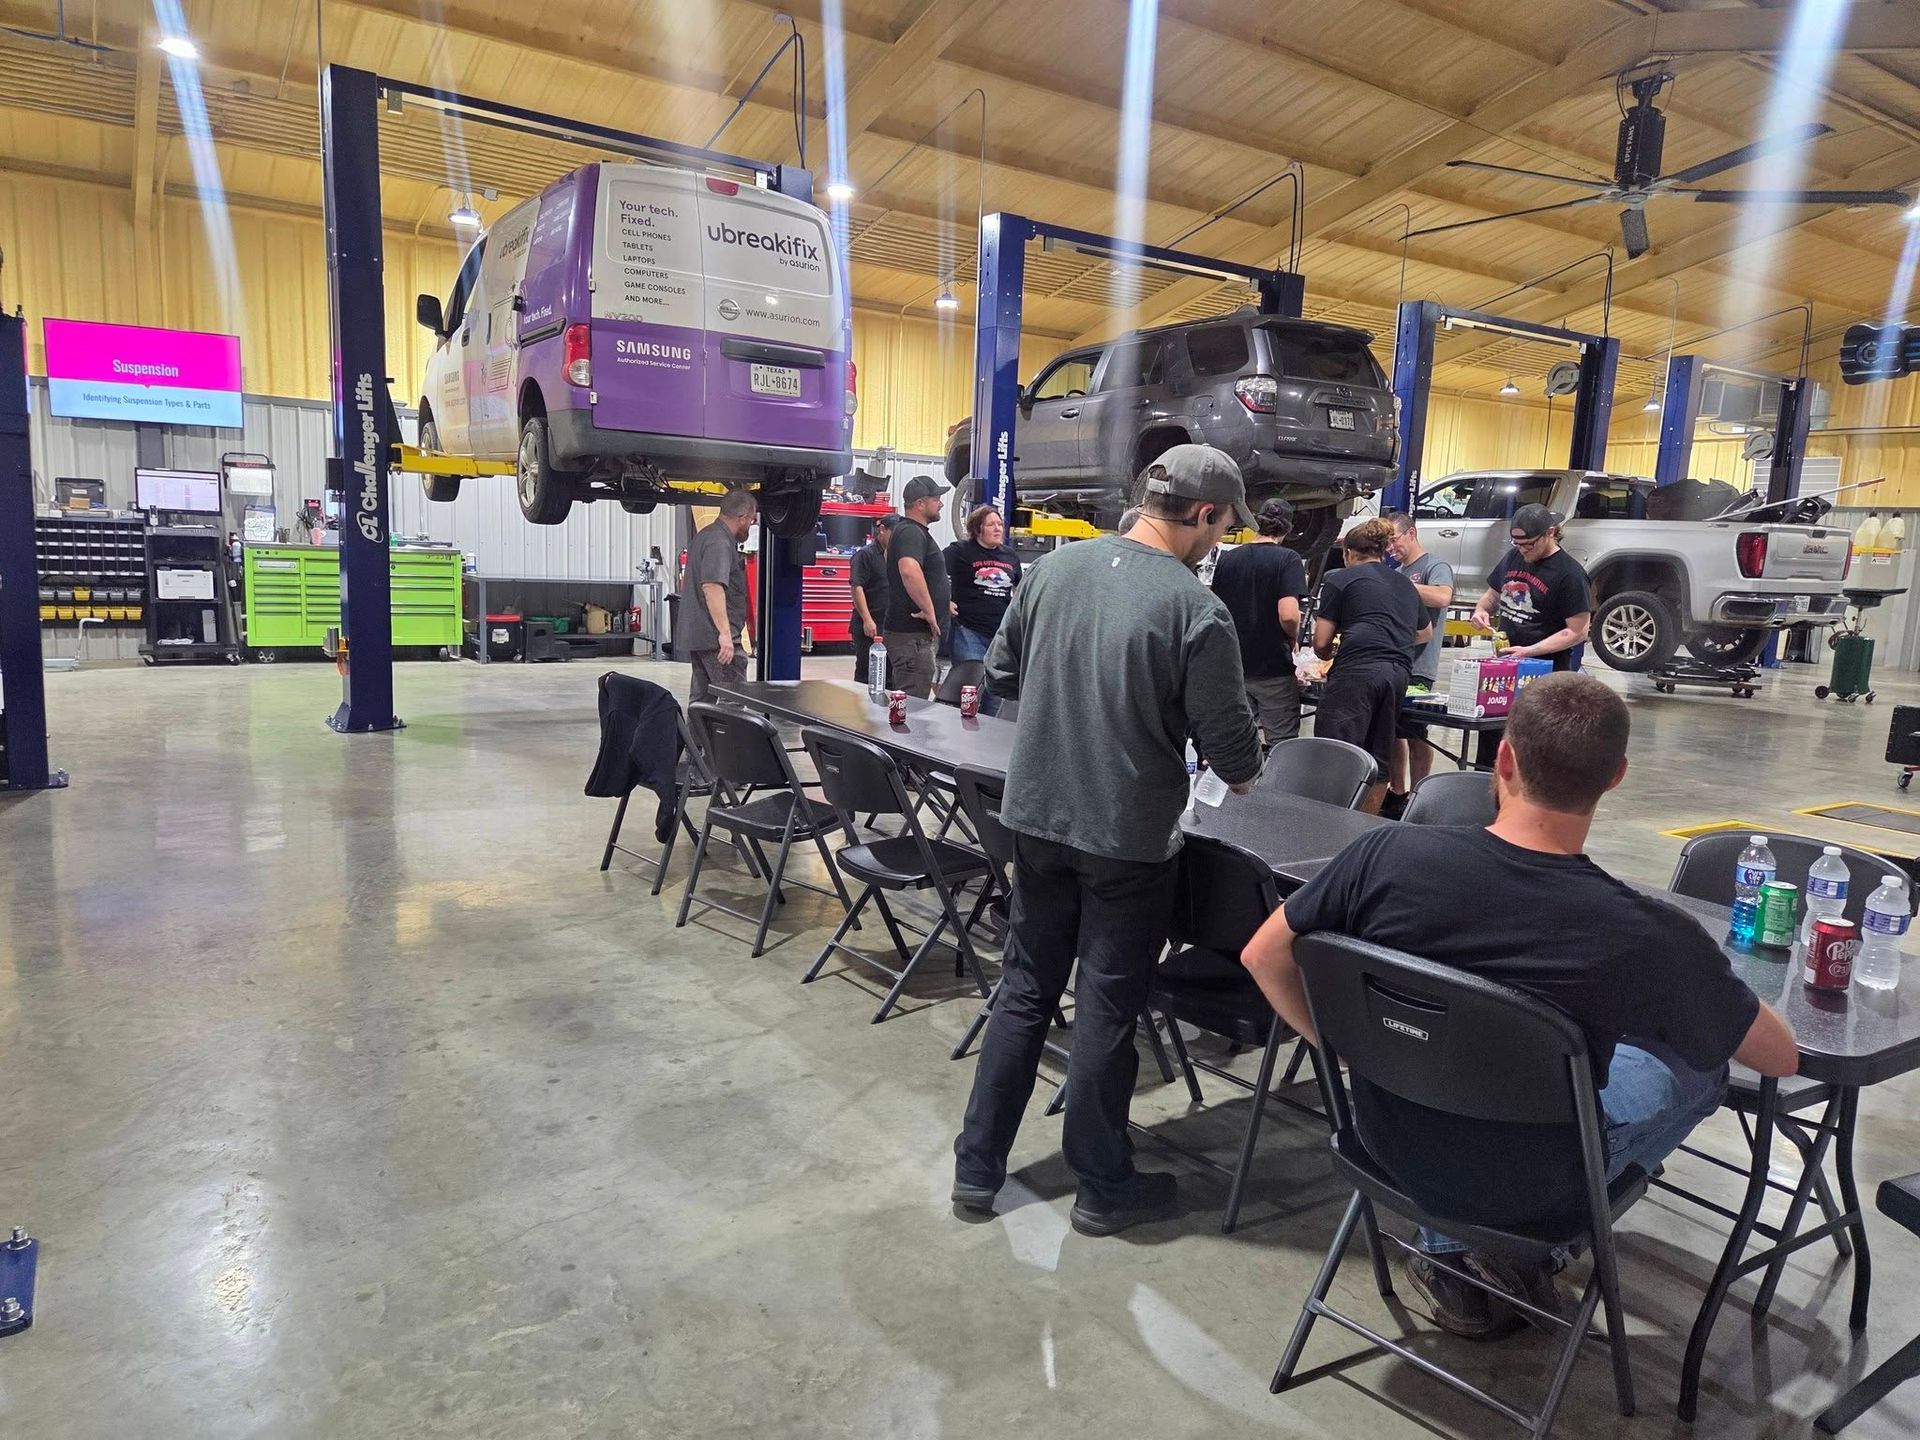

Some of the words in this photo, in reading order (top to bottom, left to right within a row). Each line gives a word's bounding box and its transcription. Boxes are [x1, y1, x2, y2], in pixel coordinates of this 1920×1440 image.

[1626, 125, 1635, 145] FANS
[1624, 145, 1632, 163] EPIC
[619, 200, 646, 212] Your
[649, 204, 679, 218] tech.
[620, 213, 655, 227] Fixed.
[622, 228, 640, 237] CELL
[642, 231, 672, 242] PHONES
[707, 222, 819, 262] ubreakifix
[622, 241, 654, 252] TABLETS
[623, 255, 656, 265] LAPTOPS
[780, 257, 789, 267] by
[789, 259, 820, 272] asurion
[624, 267, 669, 279] COMPUTERS
[624, 281, 646, 290] GAME
[647, 283, 686, 295] CONSOLES
[624, 294, 641, 303] AND
[745, 308, 821, 328] www.asurion.com
[616, 339, 691, 361] SAMSUNG
[112, 358, 179, 378] Suspension
[616, 357, 649, 367] Authorized
[649, 360, 671, 369] Service
[671, 363, 691, 371] Center
[766, 366, 786, 375] TEXAS
[83, 392, 122, 405] Identifying
[123, 395, 163, 407] Suspension
[165, 398, 184, 409] Types
[185, 400, 191, 408] &
[193, 400, 211, 410] Parts
[355, 373, 374, 411] Lifts
[997, 431, 1008, 460] Lifts
[354, 412, 380, 511] Challenger
[992, 460, 1009, 520] allenger
[1388, 1020, 1424, 1037] LIFETIME
